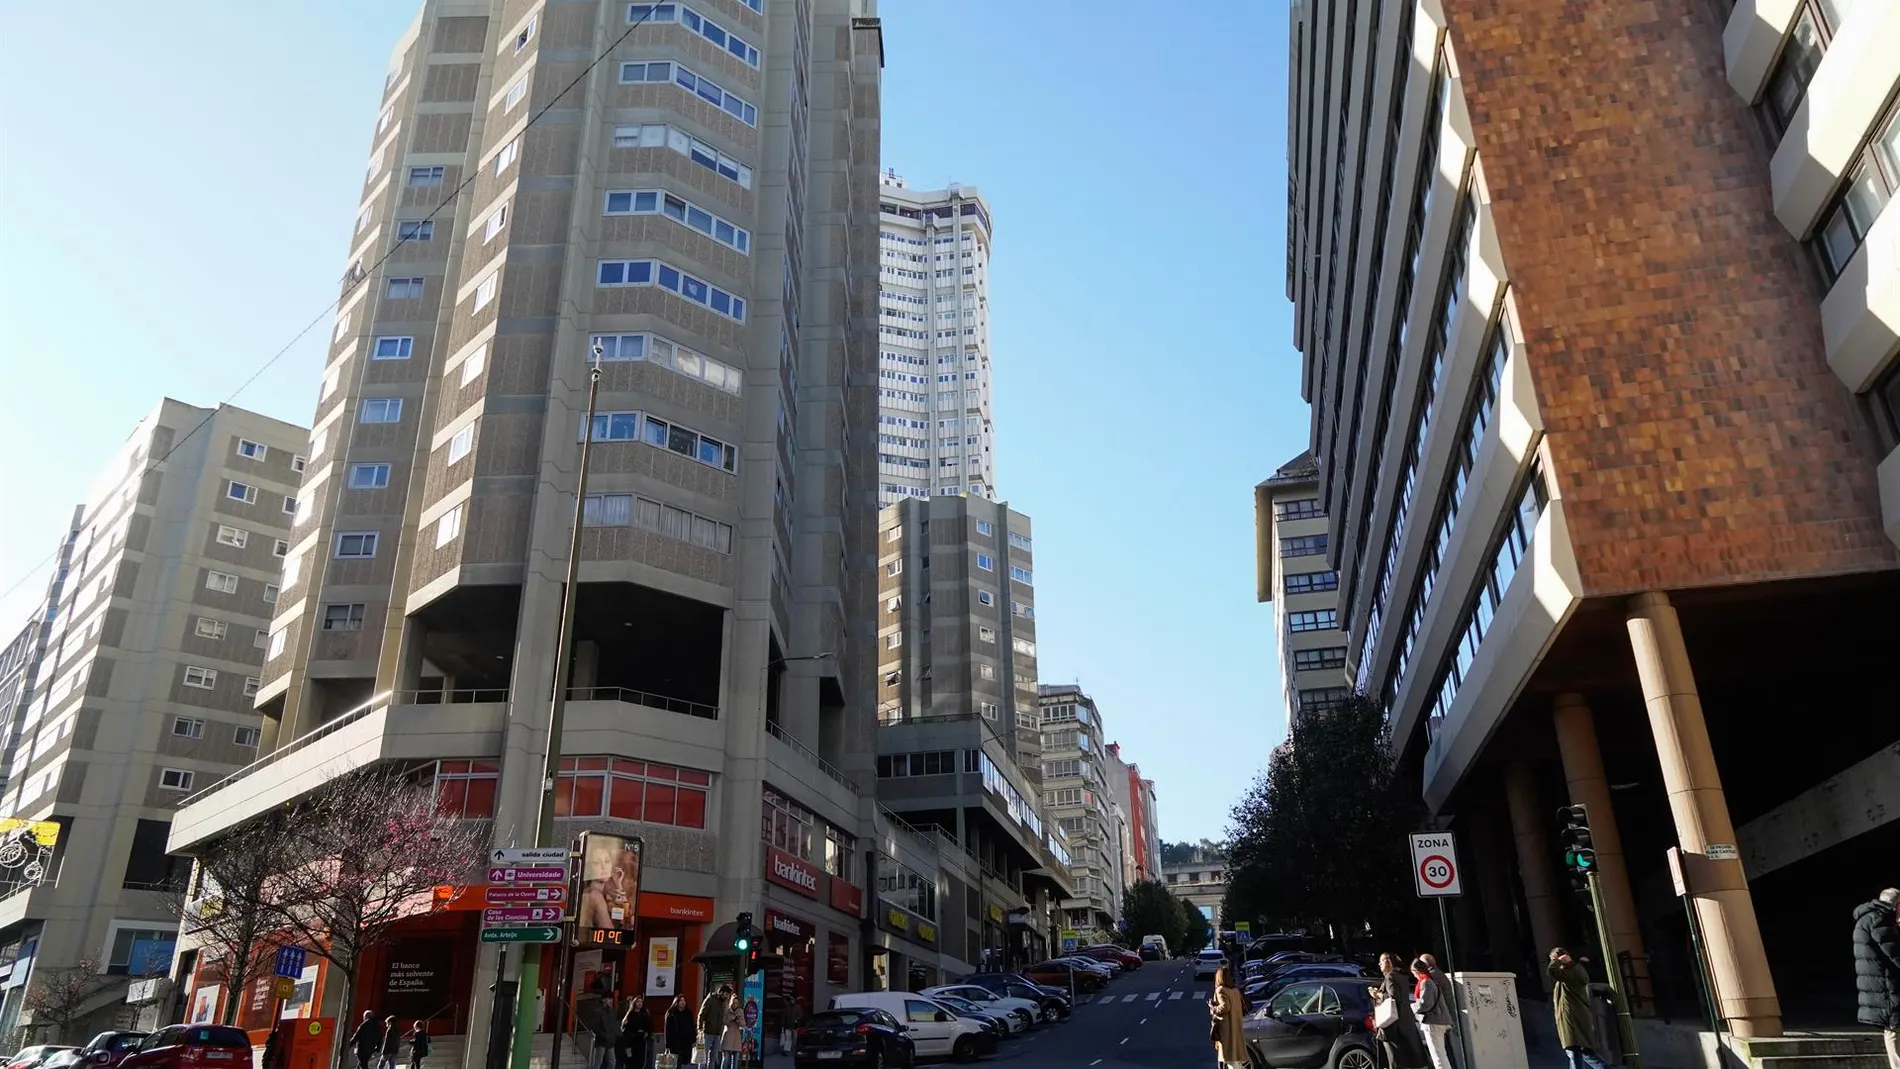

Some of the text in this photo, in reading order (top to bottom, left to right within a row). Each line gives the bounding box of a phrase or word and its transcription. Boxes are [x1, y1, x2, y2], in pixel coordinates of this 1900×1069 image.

[1417, 838, 1449, 848] ZONA
[774, 854, 816, 891] bankinter
[1428, 866, 1447, 877] 30
[670, 907, 705, 917] bankinter
[593, 930, 604, 943] 10
